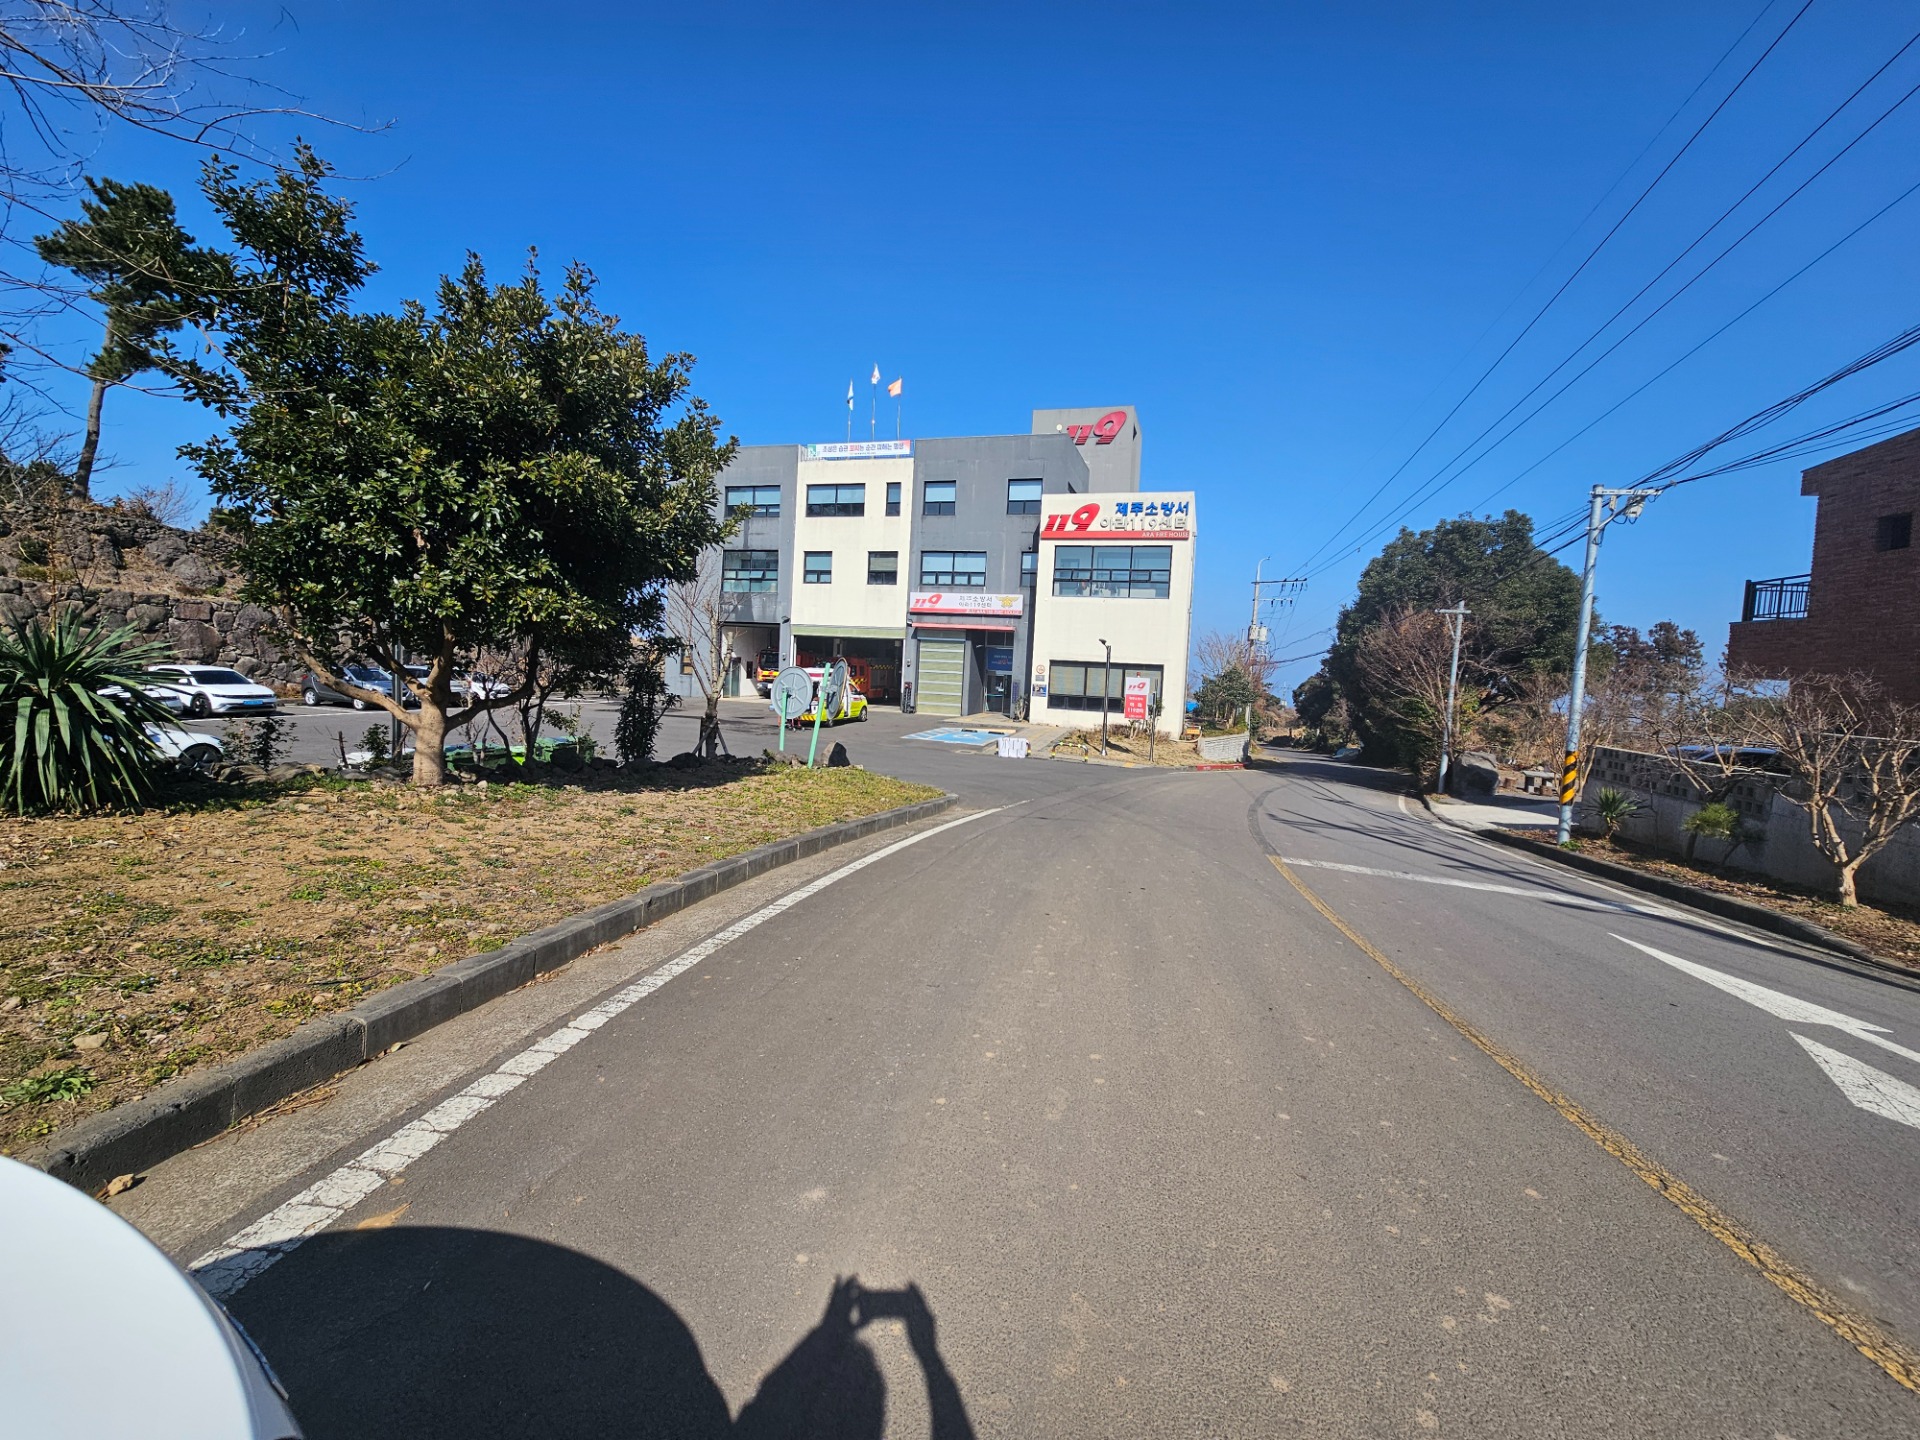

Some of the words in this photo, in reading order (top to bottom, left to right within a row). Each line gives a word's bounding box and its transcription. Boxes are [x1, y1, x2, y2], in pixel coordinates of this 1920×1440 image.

[1066, 410, 1127, 445] 119
[1115, 501, 1189, 517] 제주소방서
[1044, 503, 1101, 531] 119
[1100, 516, 1187, 531] 아라119센터
[913, 593, 943, 607] 119
[1127, 682, 1146, 691] 119
